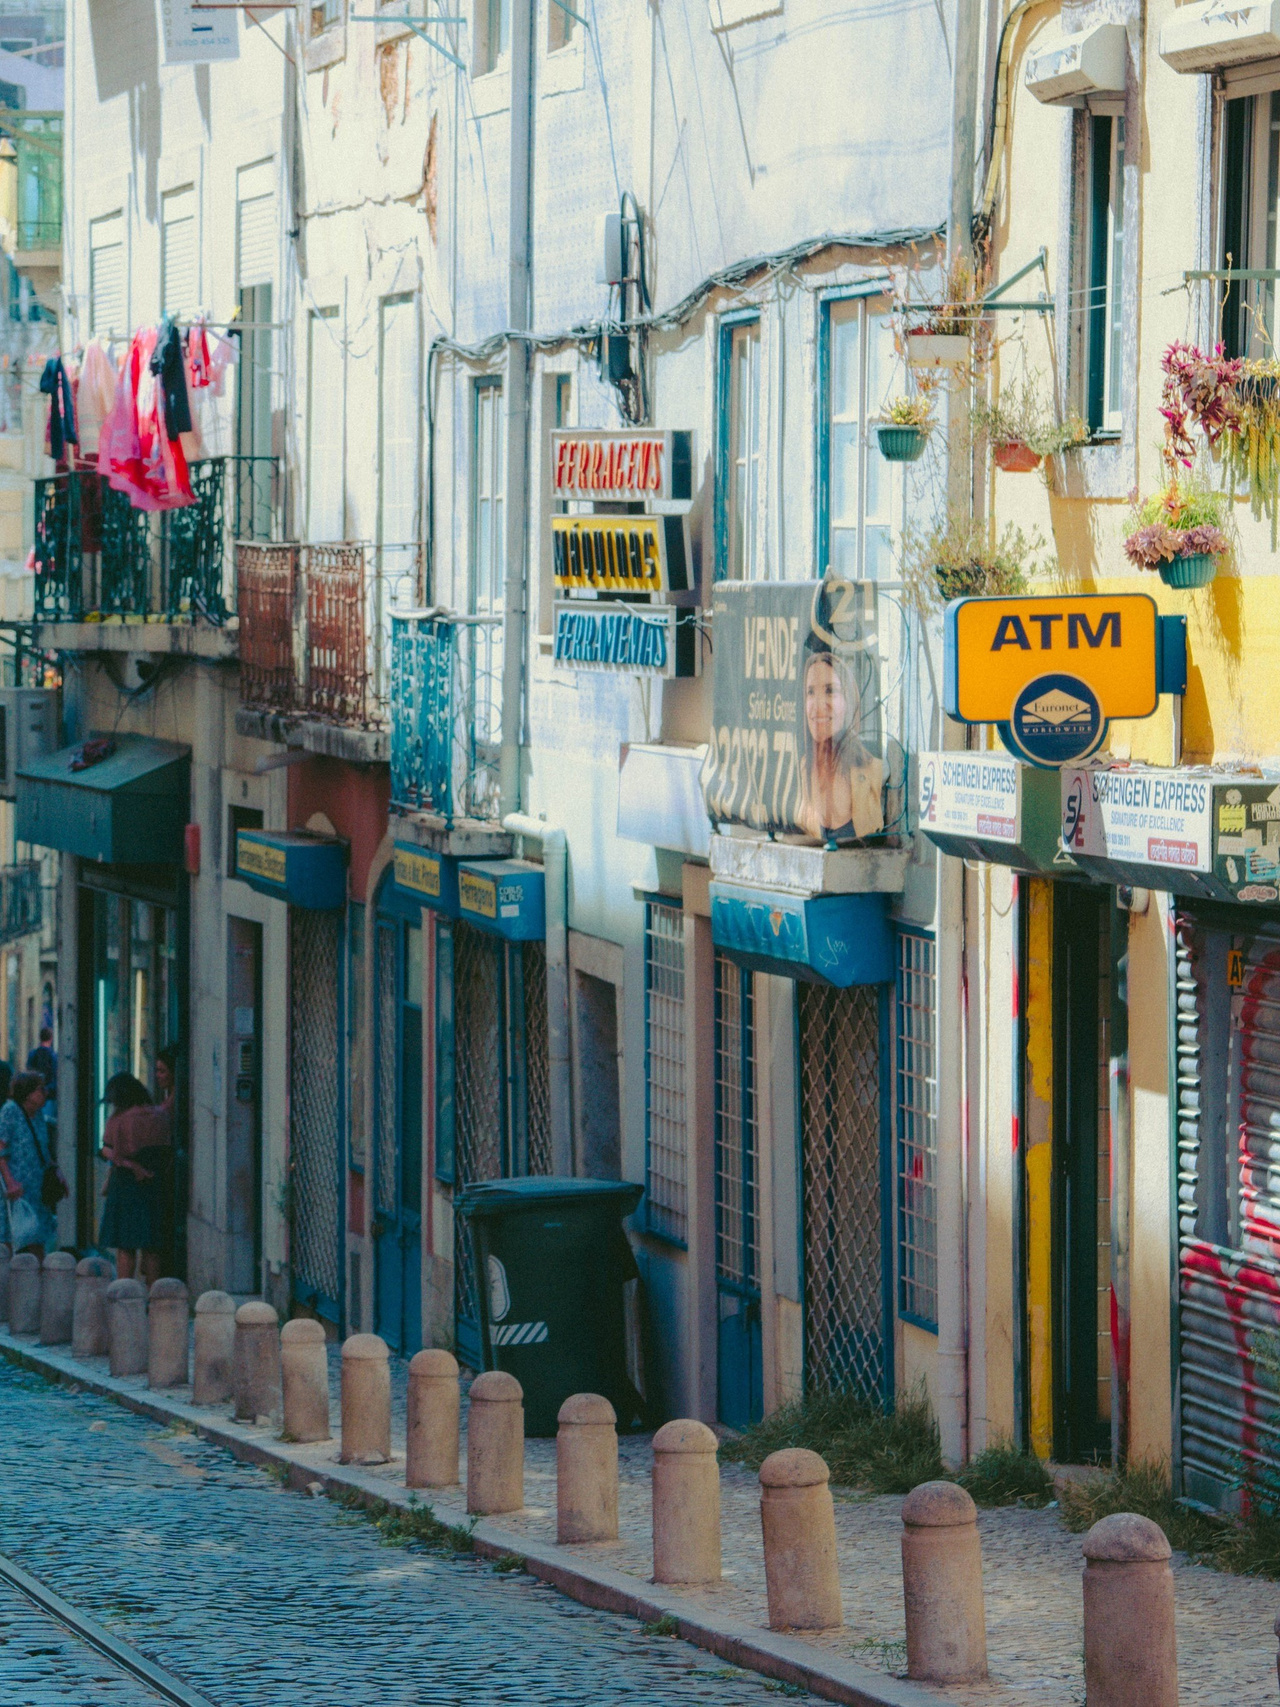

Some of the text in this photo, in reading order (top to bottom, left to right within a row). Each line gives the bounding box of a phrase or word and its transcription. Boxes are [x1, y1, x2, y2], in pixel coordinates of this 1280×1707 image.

[557, 440, 664, 491] FERRAGENS
[826, 580, 875, 623] 21
[555, 613, 668, 667] FERRAMENTAS
[744, 616, 799, 681] VENDE
[990, 612, 1122, 652] ATM
[1034, 702, 1079, 712] Euronet
[1023, 726, 1092, 734] WORLDWIDE
[943, 761, 1016, 794] SCHENGEN EXPRESS
[1093, 773, 1206, 813] SCHENGEN EXPRESS
[1111, 811, 1185, 833] SIGNATURE OF EXCELLENCE
